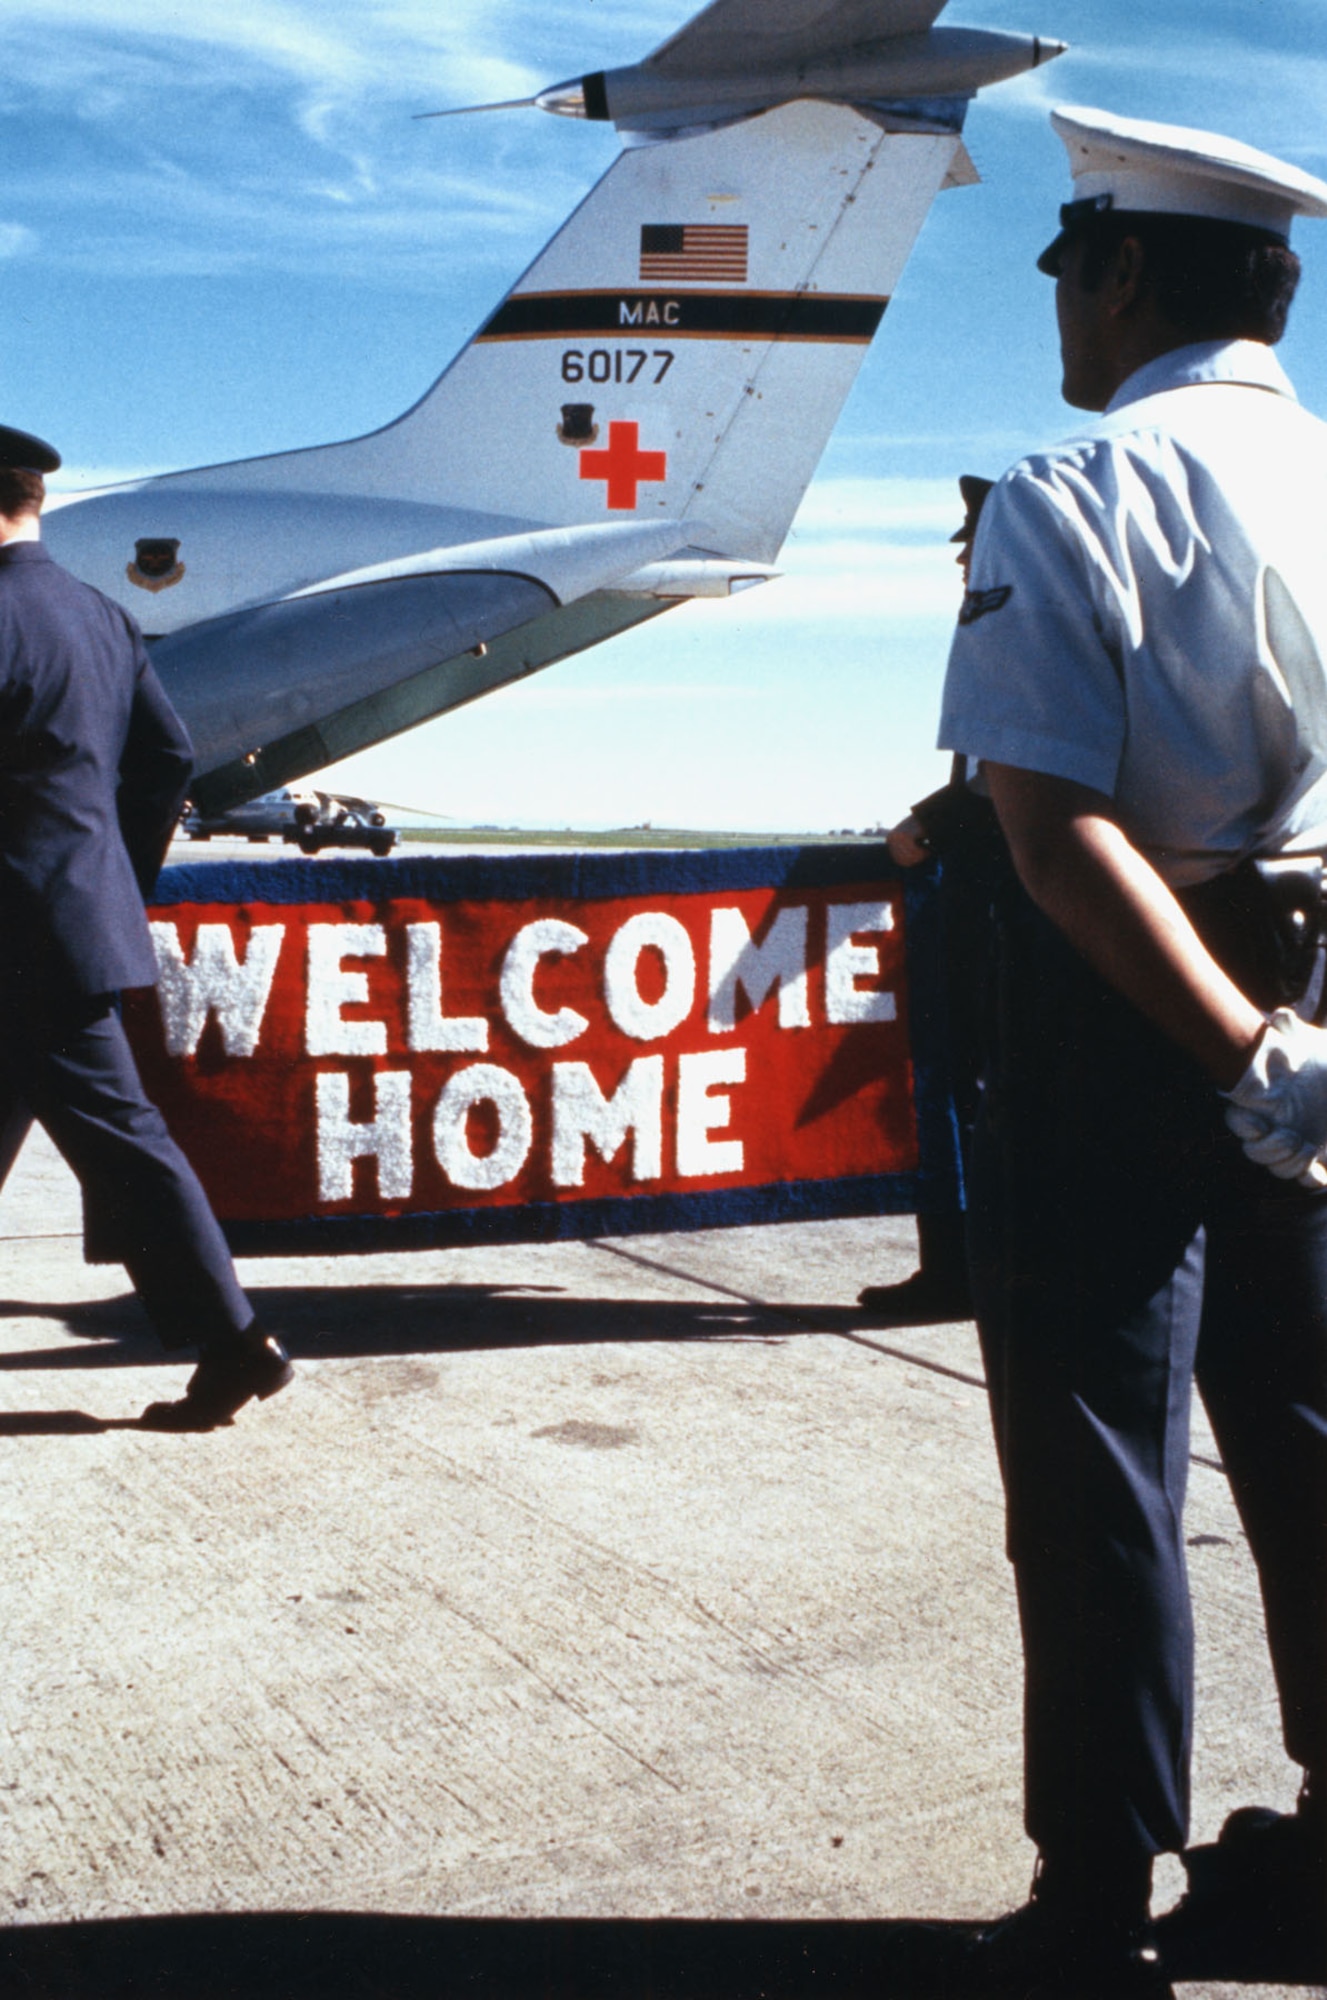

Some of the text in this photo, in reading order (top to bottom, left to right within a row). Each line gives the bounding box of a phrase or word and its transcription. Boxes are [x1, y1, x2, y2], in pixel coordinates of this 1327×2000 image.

[619, 301, 680, 325] MAC
[561, 350, 675, 384] 60177
[149, 901, 898, 1058] WELCOME
[315, 1046, 748, 1202] HOME
